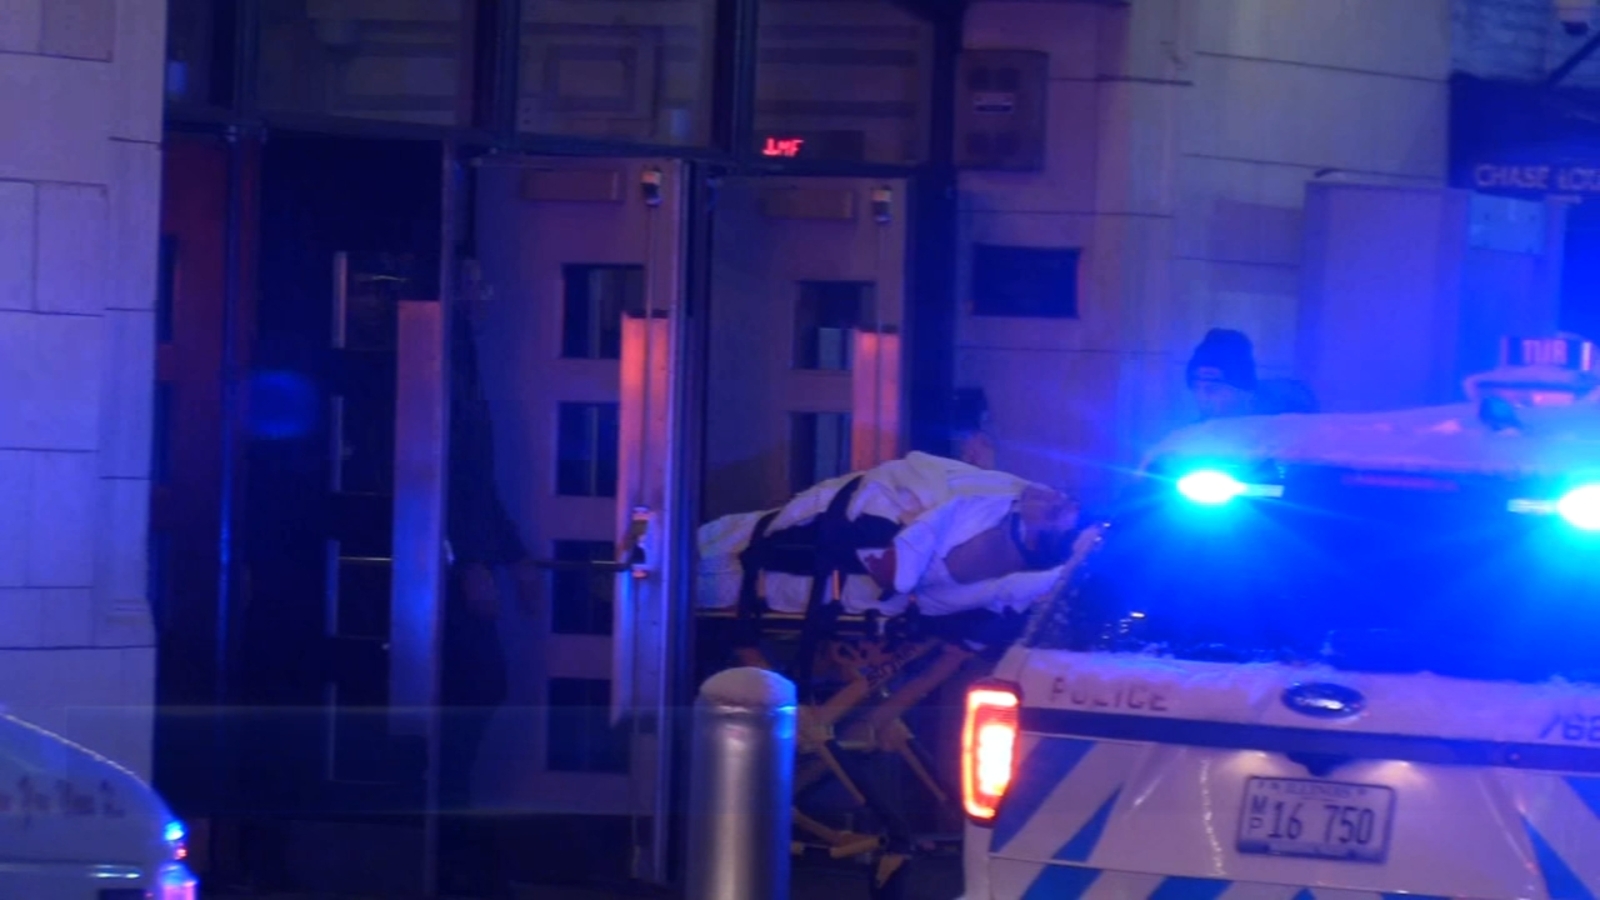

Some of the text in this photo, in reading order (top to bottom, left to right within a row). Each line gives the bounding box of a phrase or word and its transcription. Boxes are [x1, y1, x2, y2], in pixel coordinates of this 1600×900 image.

[1474, 164, 1550, 190] CHASE
[1268, 801, 1376, 846] 16 750
